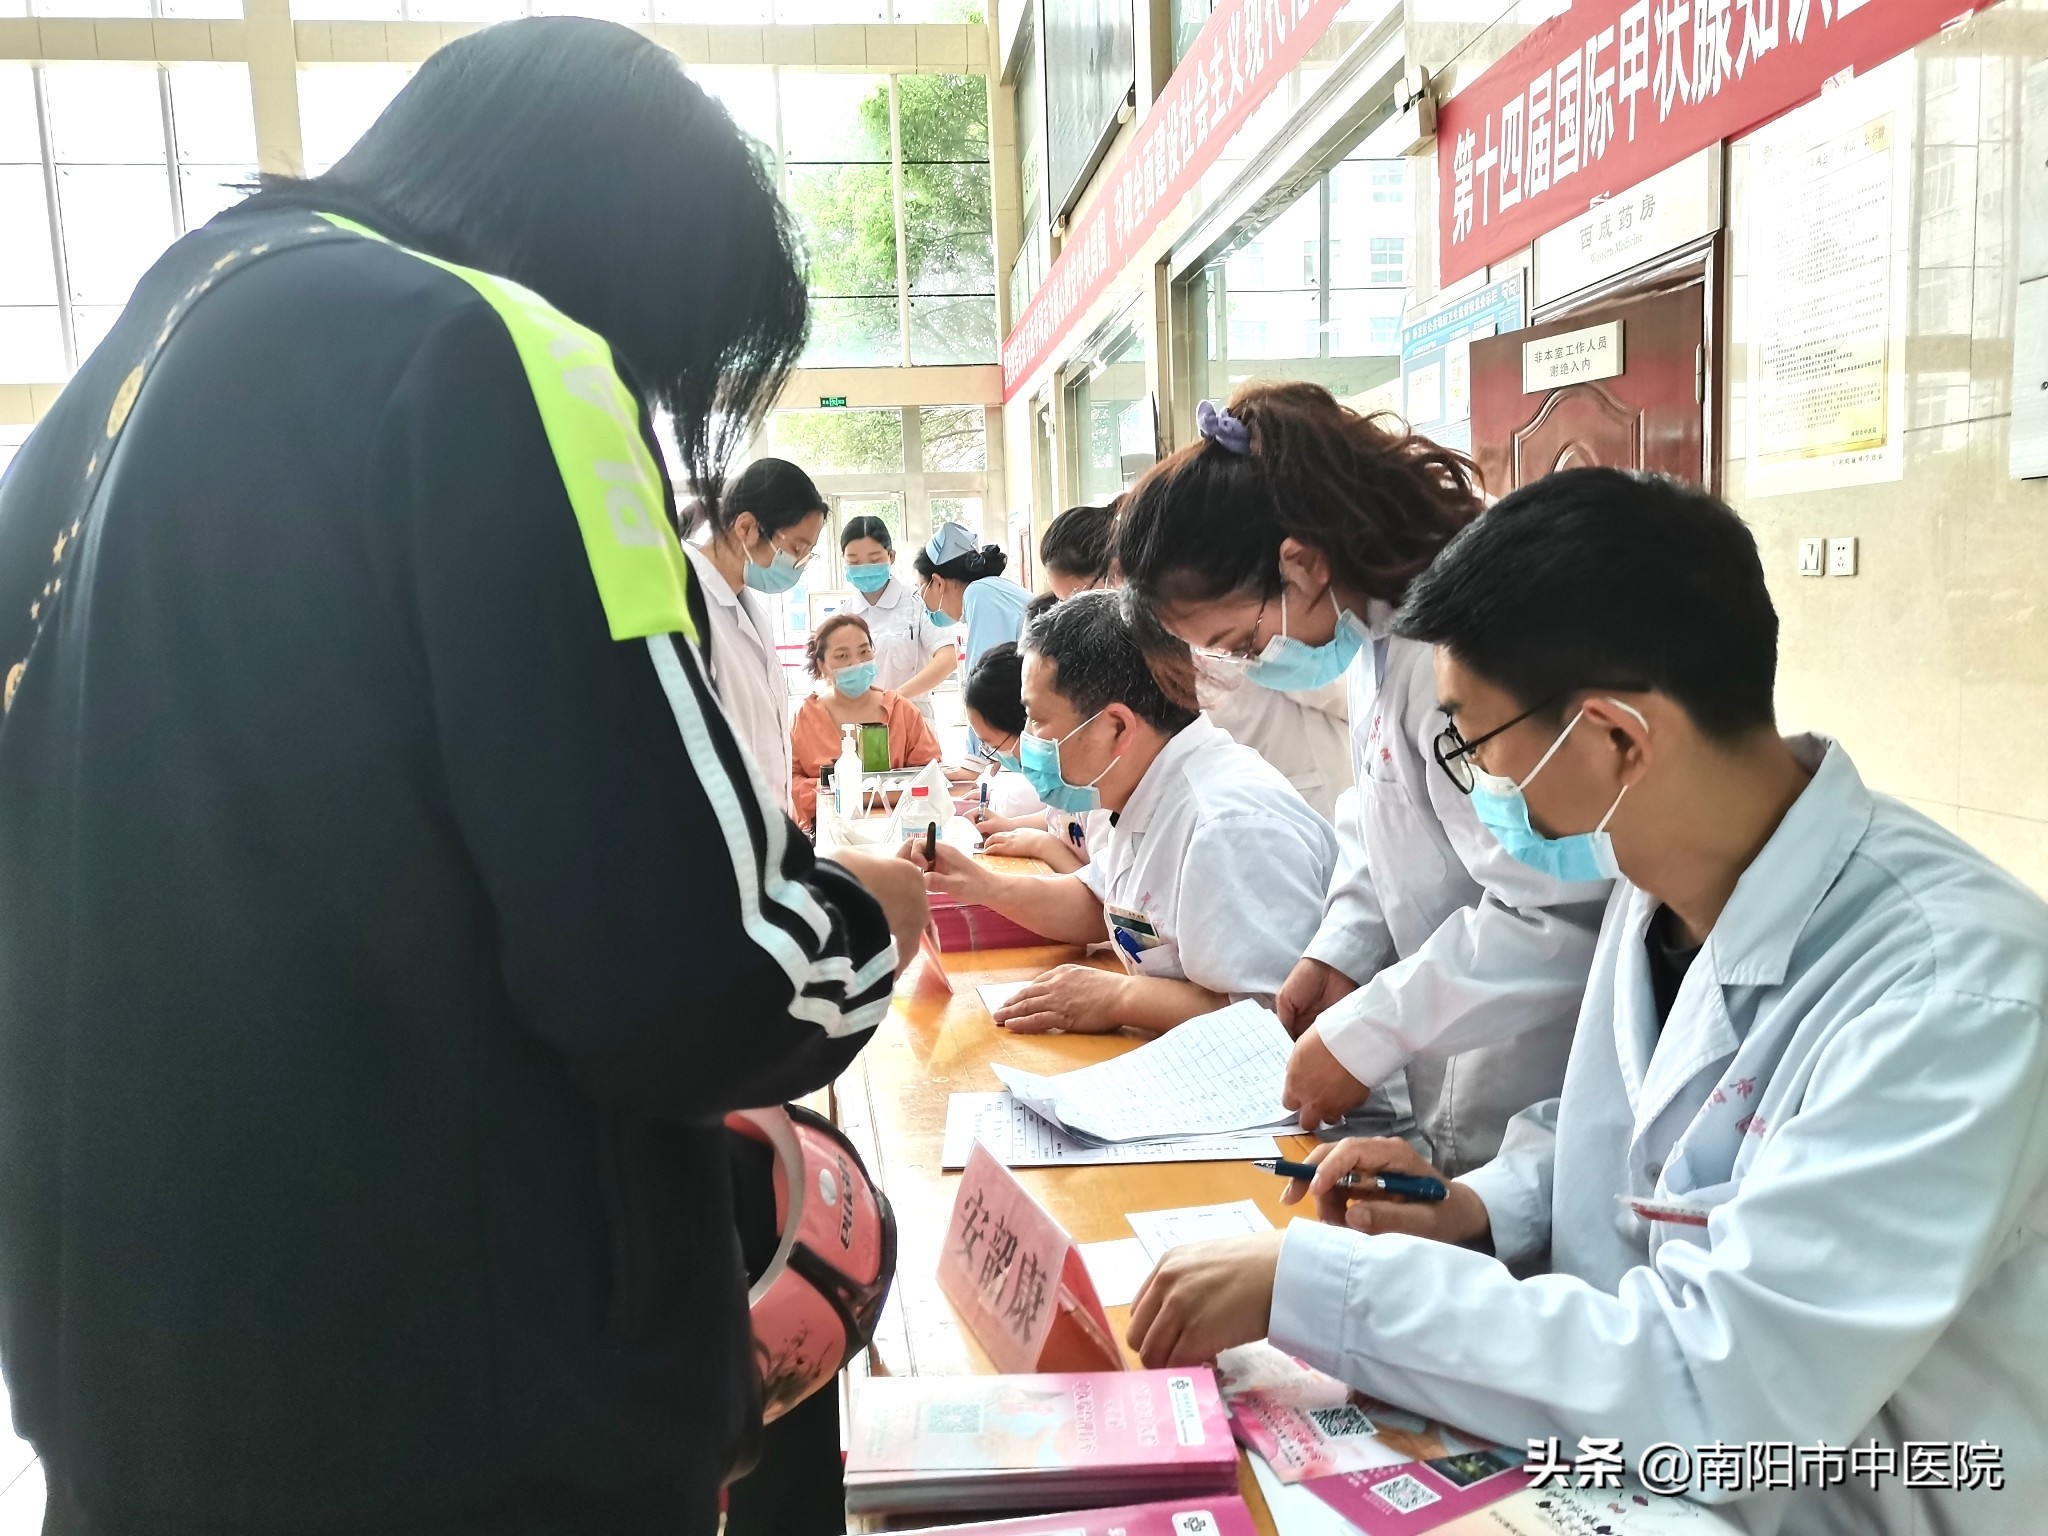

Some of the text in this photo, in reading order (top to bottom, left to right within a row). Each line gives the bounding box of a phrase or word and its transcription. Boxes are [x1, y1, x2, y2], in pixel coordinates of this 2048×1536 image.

[1451, 0, 1872, 245] 第十四届国际甲状腺知
[1579, 194, 1656, 250] 西成药房
[1614, 233, 1643, 253] Medicine
[1534, 336, 1607, 363] 非本室工作人员
[1550, 357, 1591, 377] 谢绝入内
